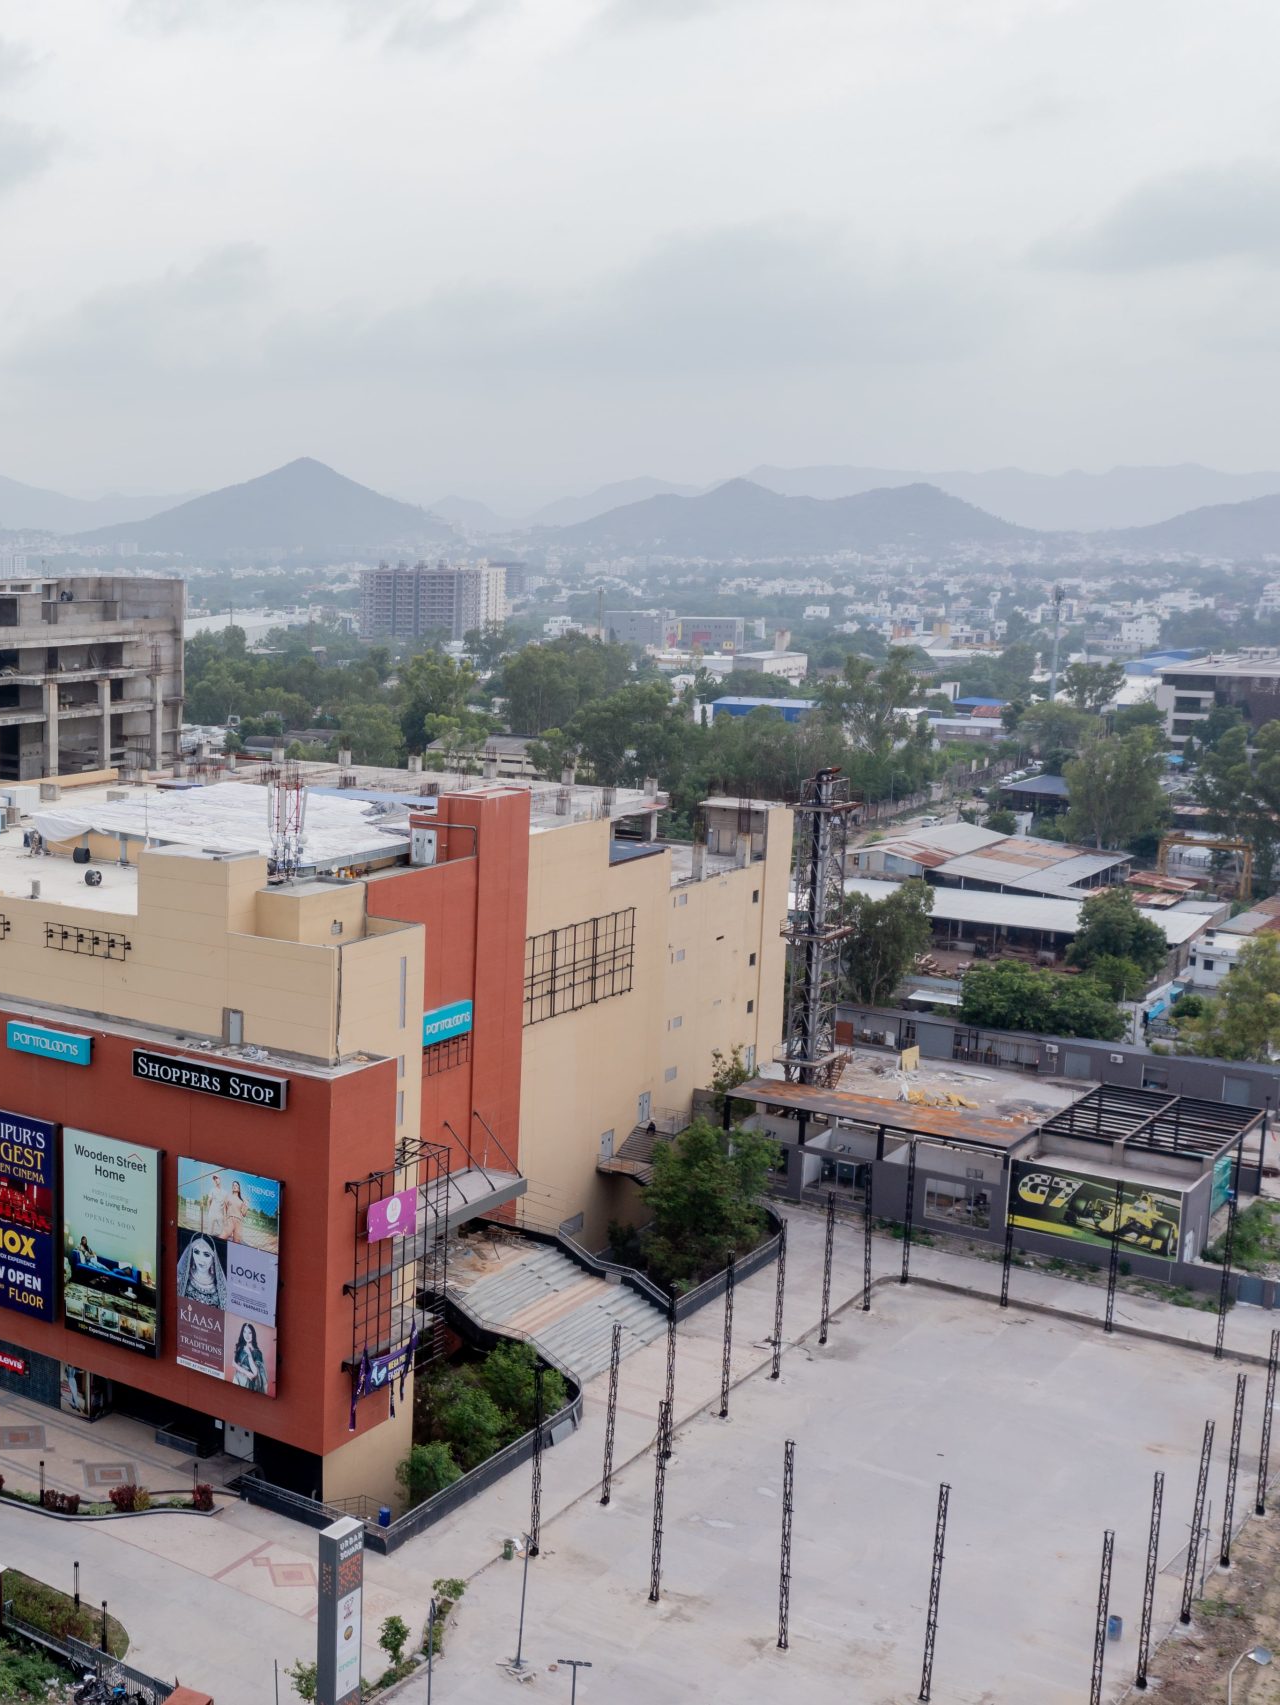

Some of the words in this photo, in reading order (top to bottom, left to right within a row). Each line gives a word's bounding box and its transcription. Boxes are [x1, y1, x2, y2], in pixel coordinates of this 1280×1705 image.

[137, 1056, 221, 1092] SHOPPERS
[229, 1077, 275, 1104] STOP
[74, 1143, 115, 1165] Wooden
[116, 1155, 147, 1173] Street
[12, 1166, 45, 1184] CINEMA
[94, 1164, 126, 1183] Home
[248, 1184, 276, 1198] TRENDS
[1018, 1173, 1084, 1208] G7
[7, 1268, 42, 1292] OPEN
[231, 1264, 266, 1284] LOOKS
[8, 1286, 44, 1309] FLOOR
[180, 1335, 222, 1355] TRADITIONS
[339, 1530, 363, 1551] URBAN
